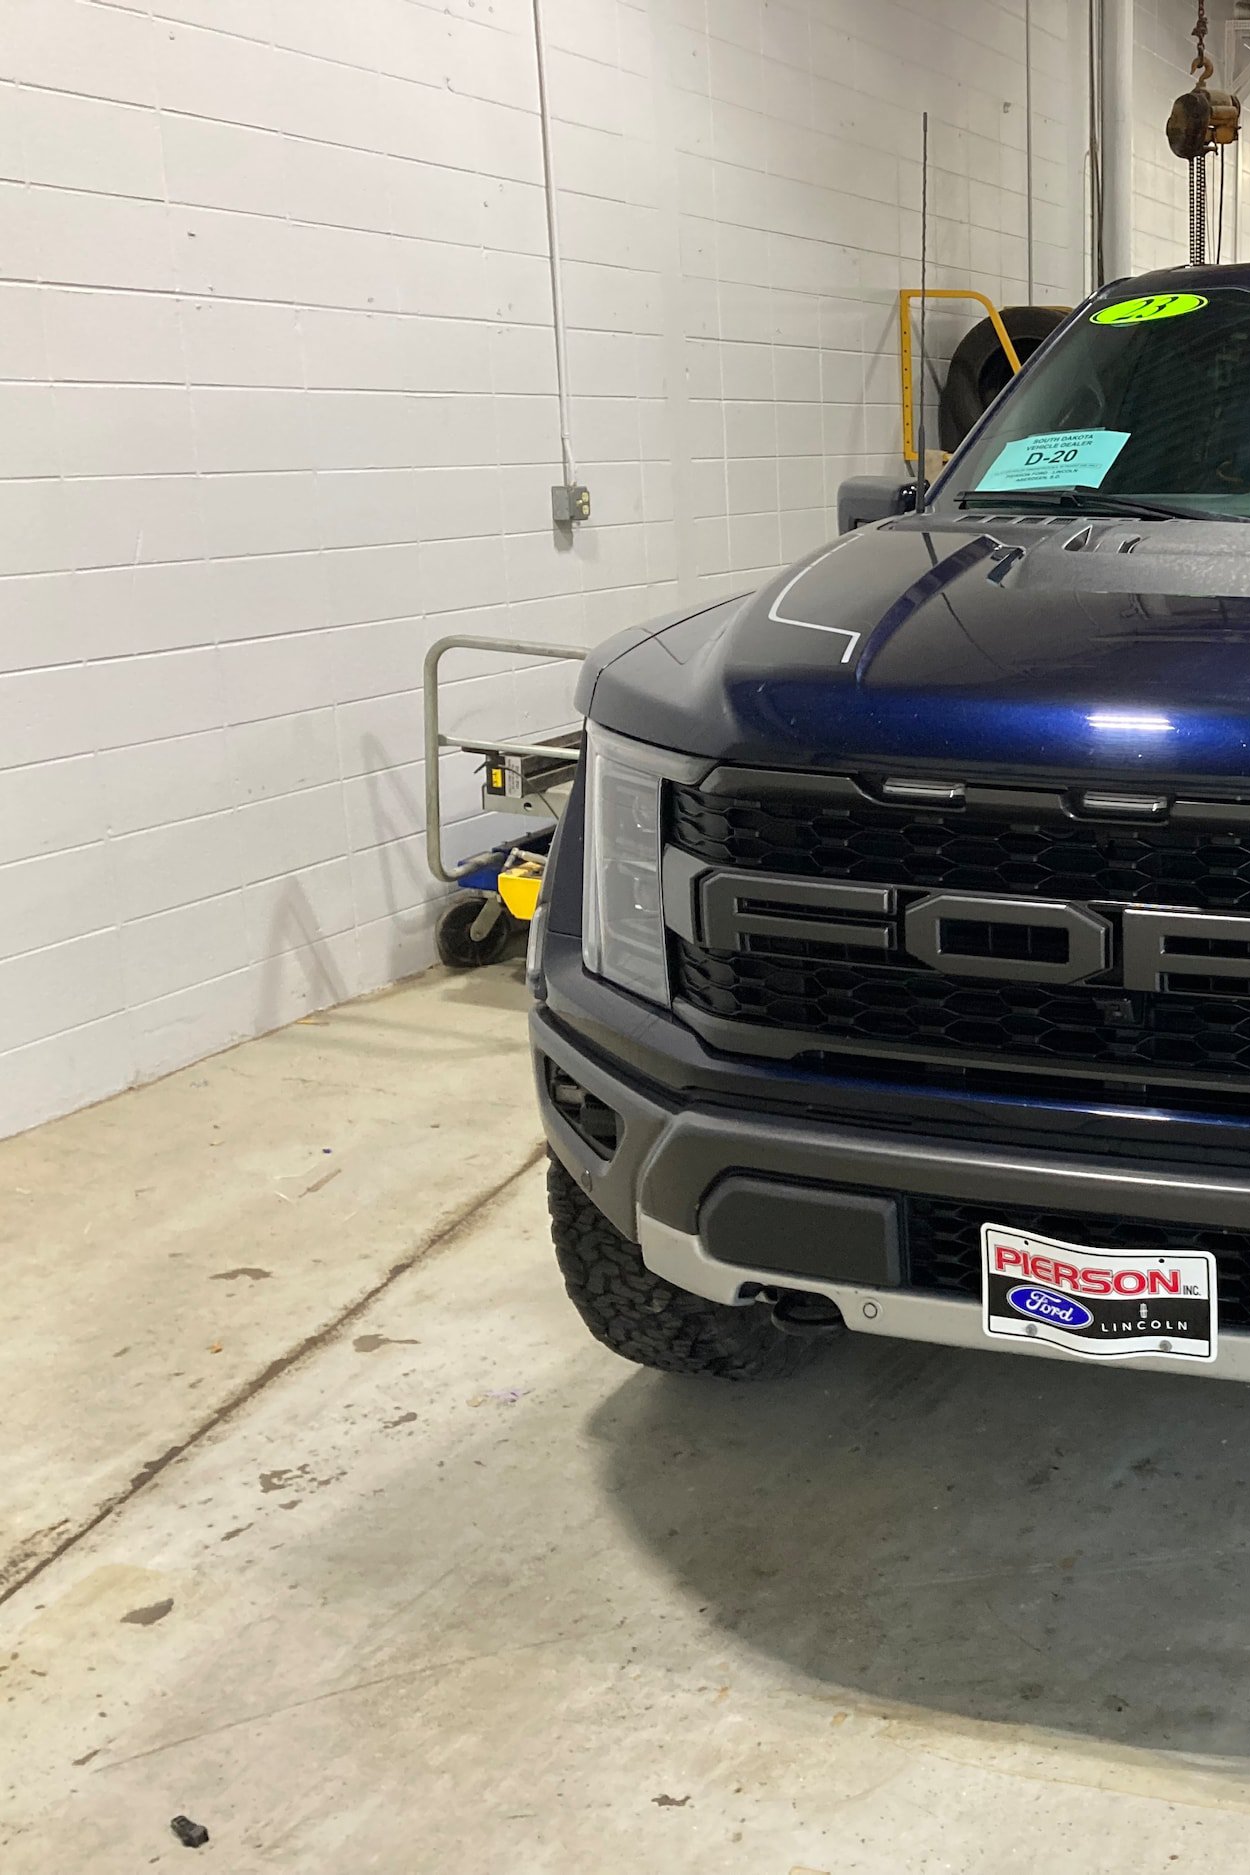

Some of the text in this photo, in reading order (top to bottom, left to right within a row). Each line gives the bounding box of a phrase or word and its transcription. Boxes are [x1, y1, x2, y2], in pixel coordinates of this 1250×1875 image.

[1026, 443, 1059, 451] VEHICLE
[1024, 449, 1078, 466] D-20
[994, 1243, 1202, 1296] PIERSON INC.
[1025, 1289, 1074, 1323] Ford
[1100, 1320, 1189, 1333] LINCOLN
